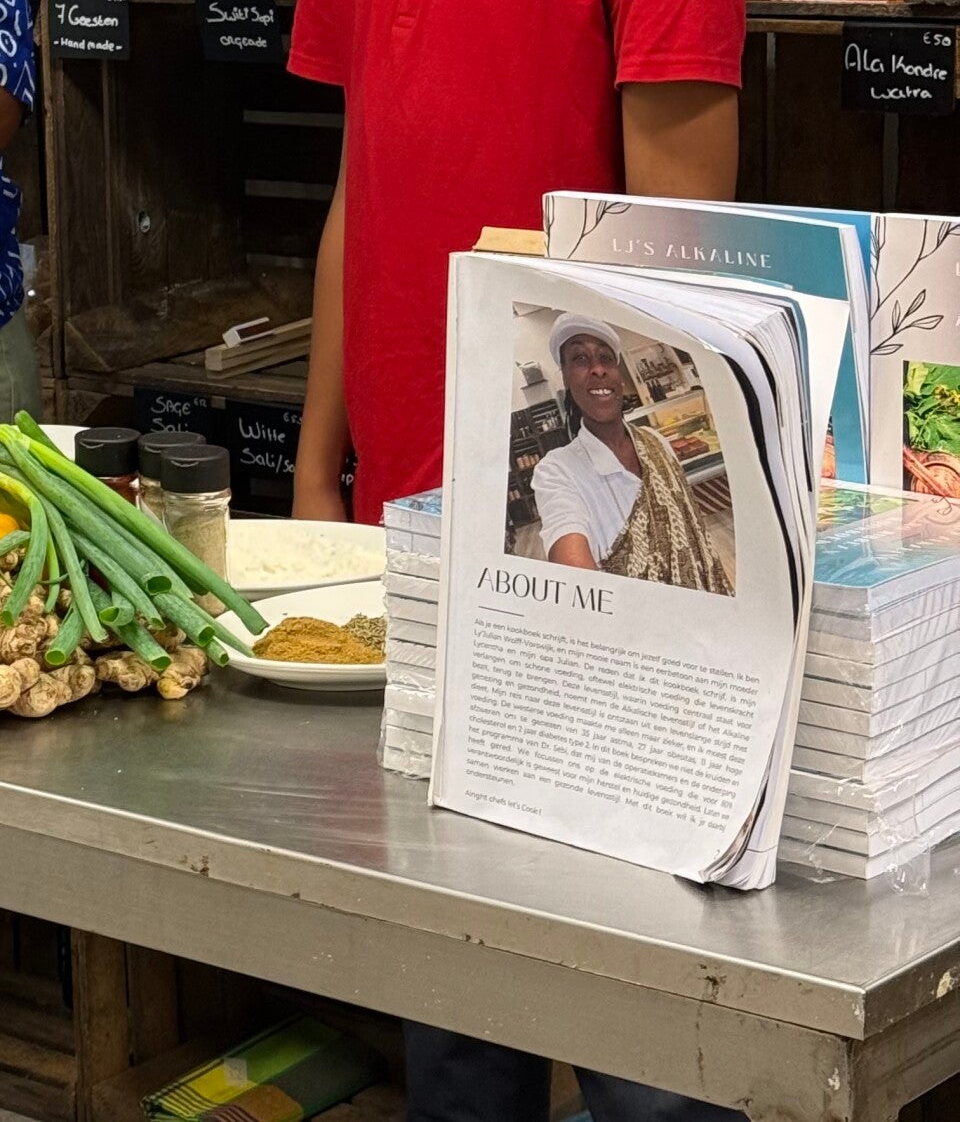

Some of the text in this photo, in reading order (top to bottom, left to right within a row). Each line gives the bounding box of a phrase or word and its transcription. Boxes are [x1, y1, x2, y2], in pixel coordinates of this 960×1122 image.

[612, 238, 772, 269] LJ'S ALKALINE
[477, 567, 615, 616] ABOUT ME
